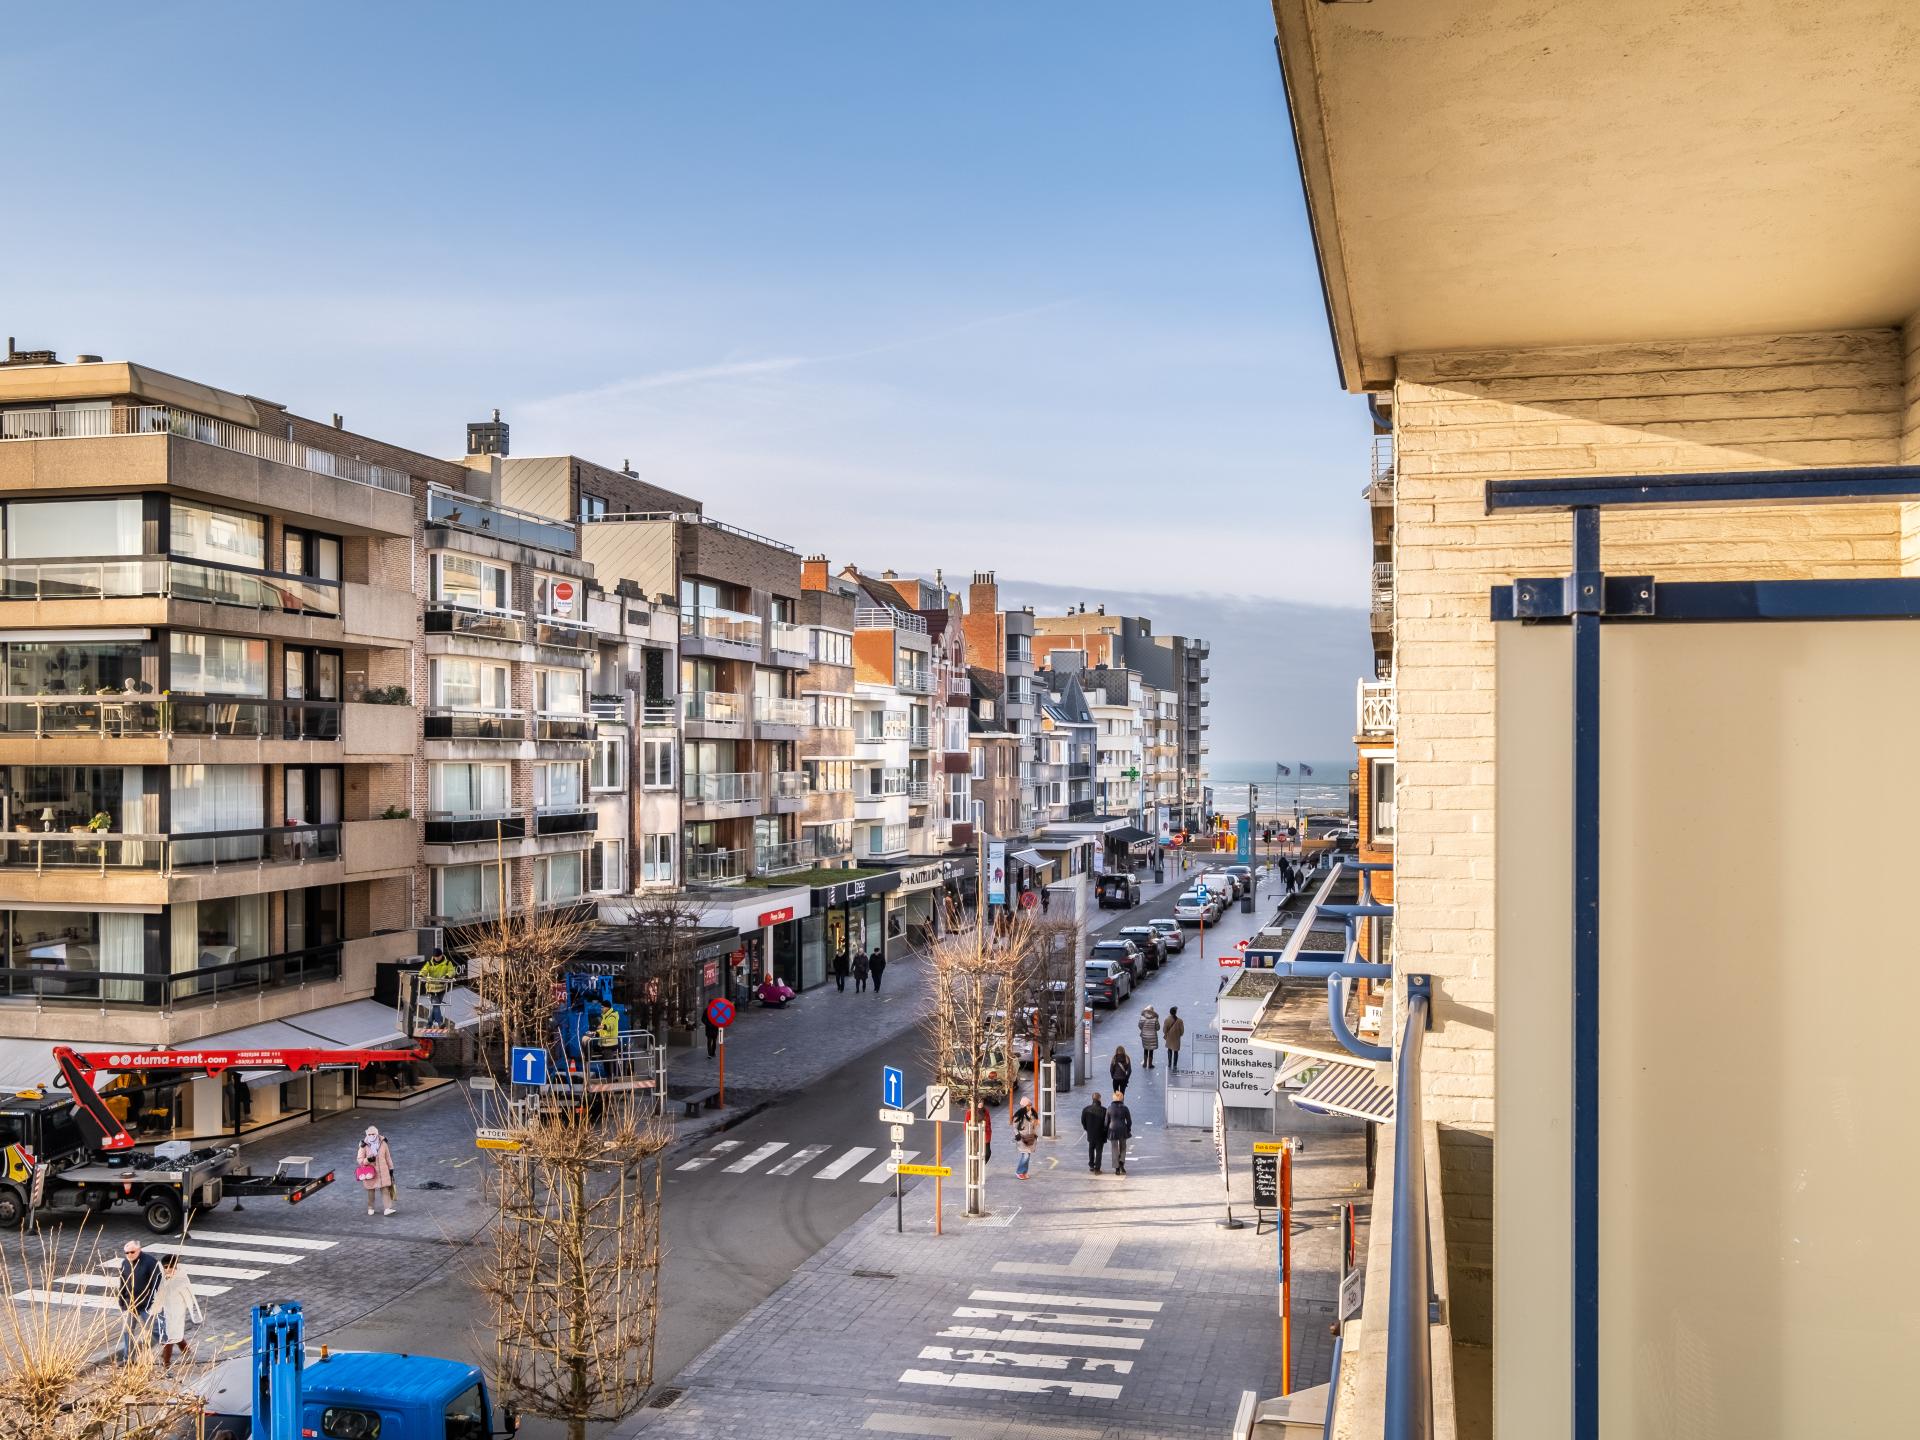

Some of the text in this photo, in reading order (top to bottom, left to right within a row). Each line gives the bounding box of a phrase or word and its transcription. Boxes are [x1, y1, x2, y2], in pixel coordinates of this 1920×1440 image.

[1221, 1046, 1254, 1056] Glaces
[1221, 1058, 1273, 1069] Milkshakes
[1222, 1070, 1254, 1079] Wafels
[1221, 1081, 1259, 1091] Gaufres
